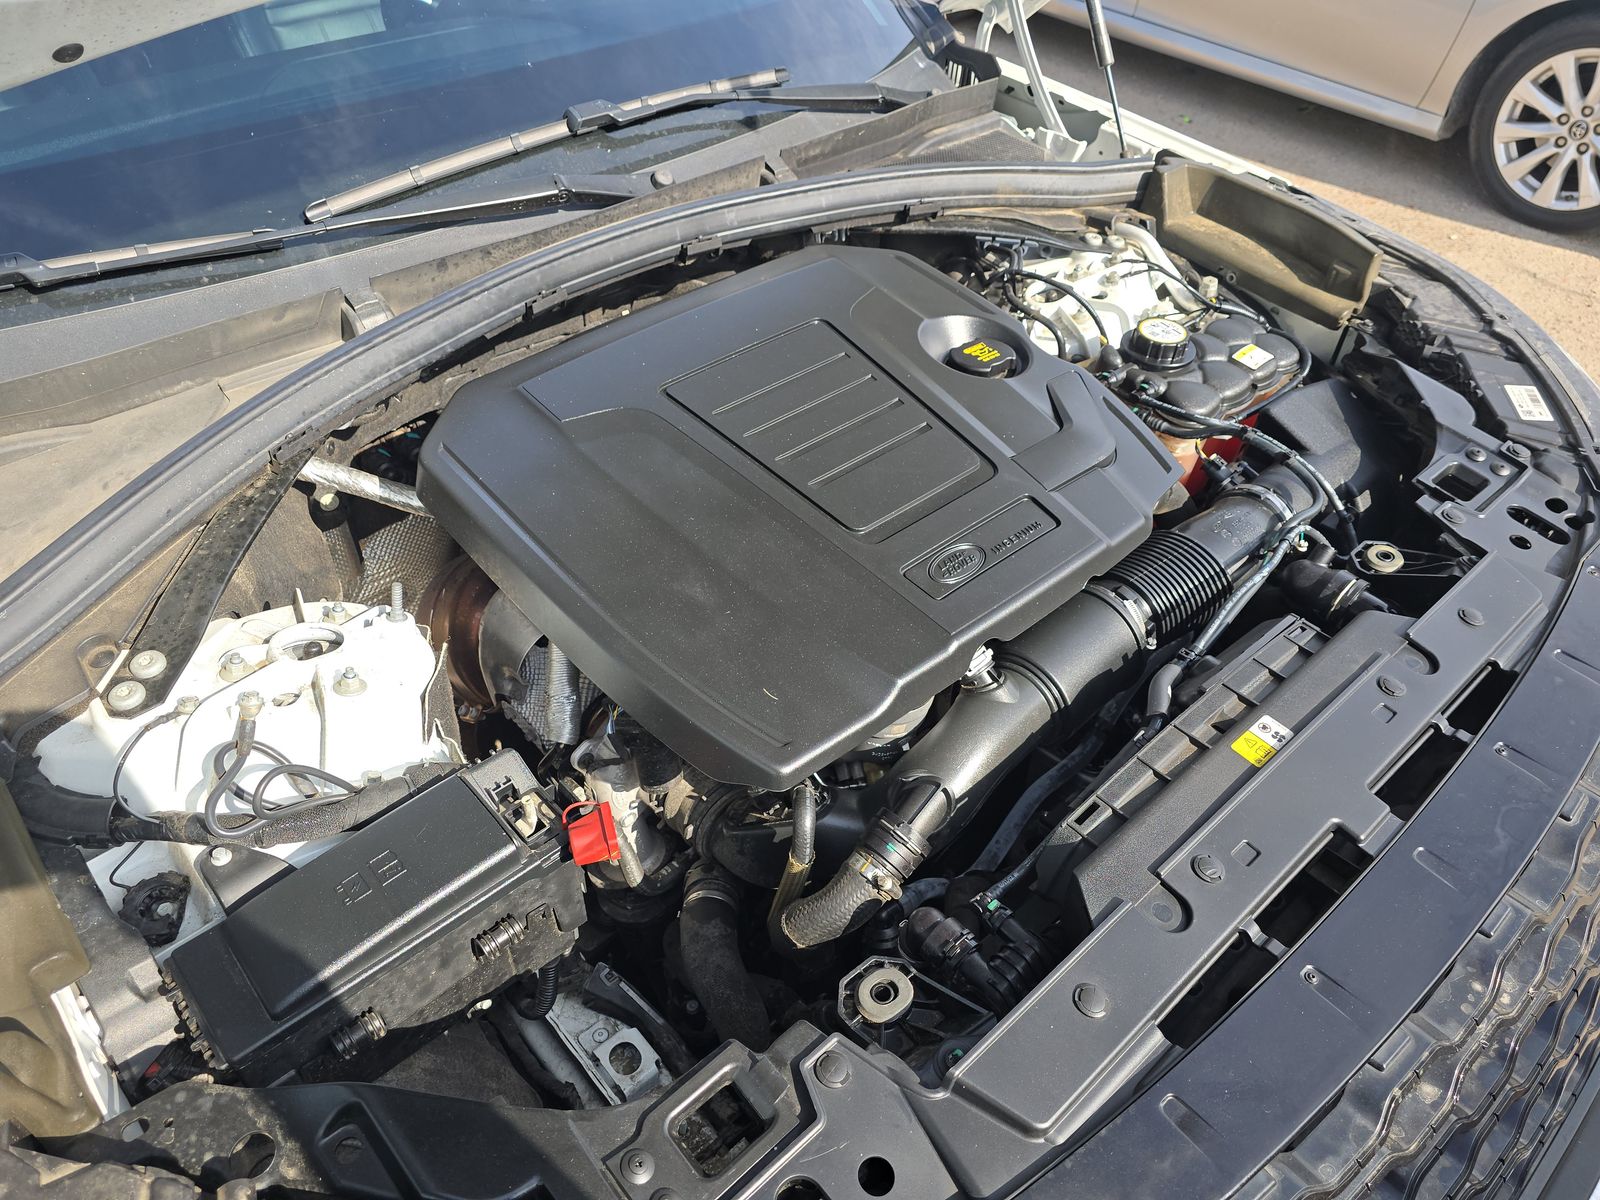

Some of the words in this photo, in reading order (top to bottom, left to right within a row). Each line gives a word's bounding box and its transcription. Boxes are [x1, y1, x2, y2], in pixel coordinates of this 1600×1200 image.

[991, 521, 1043, 555] INGENIUM
[937, 551, 965, 571] LAND
[947, 554, 978, 577] ROVER
